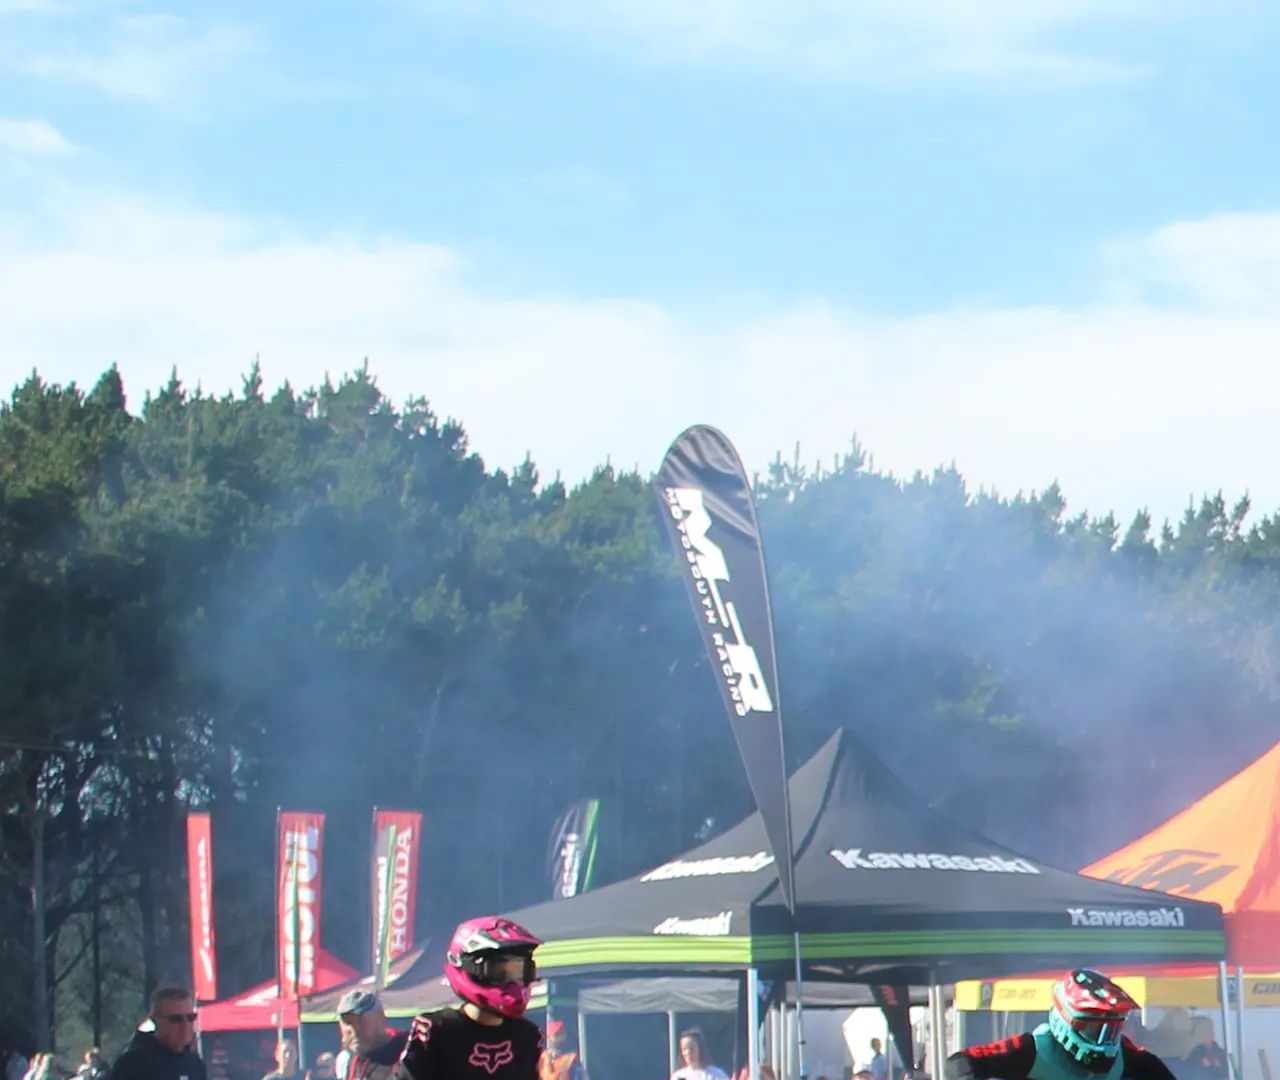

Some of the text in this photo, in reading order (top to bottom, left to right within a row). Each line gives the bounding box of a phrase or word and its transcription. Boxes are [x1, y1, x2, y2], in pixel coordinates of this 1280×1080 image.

[712, 632, 747, 717] RACING
[831, 848, 1040, 875] Kawasaki
[390, 827, 412, 954] HONDA
[1068, 908, 1184, 928] Kawasaki
